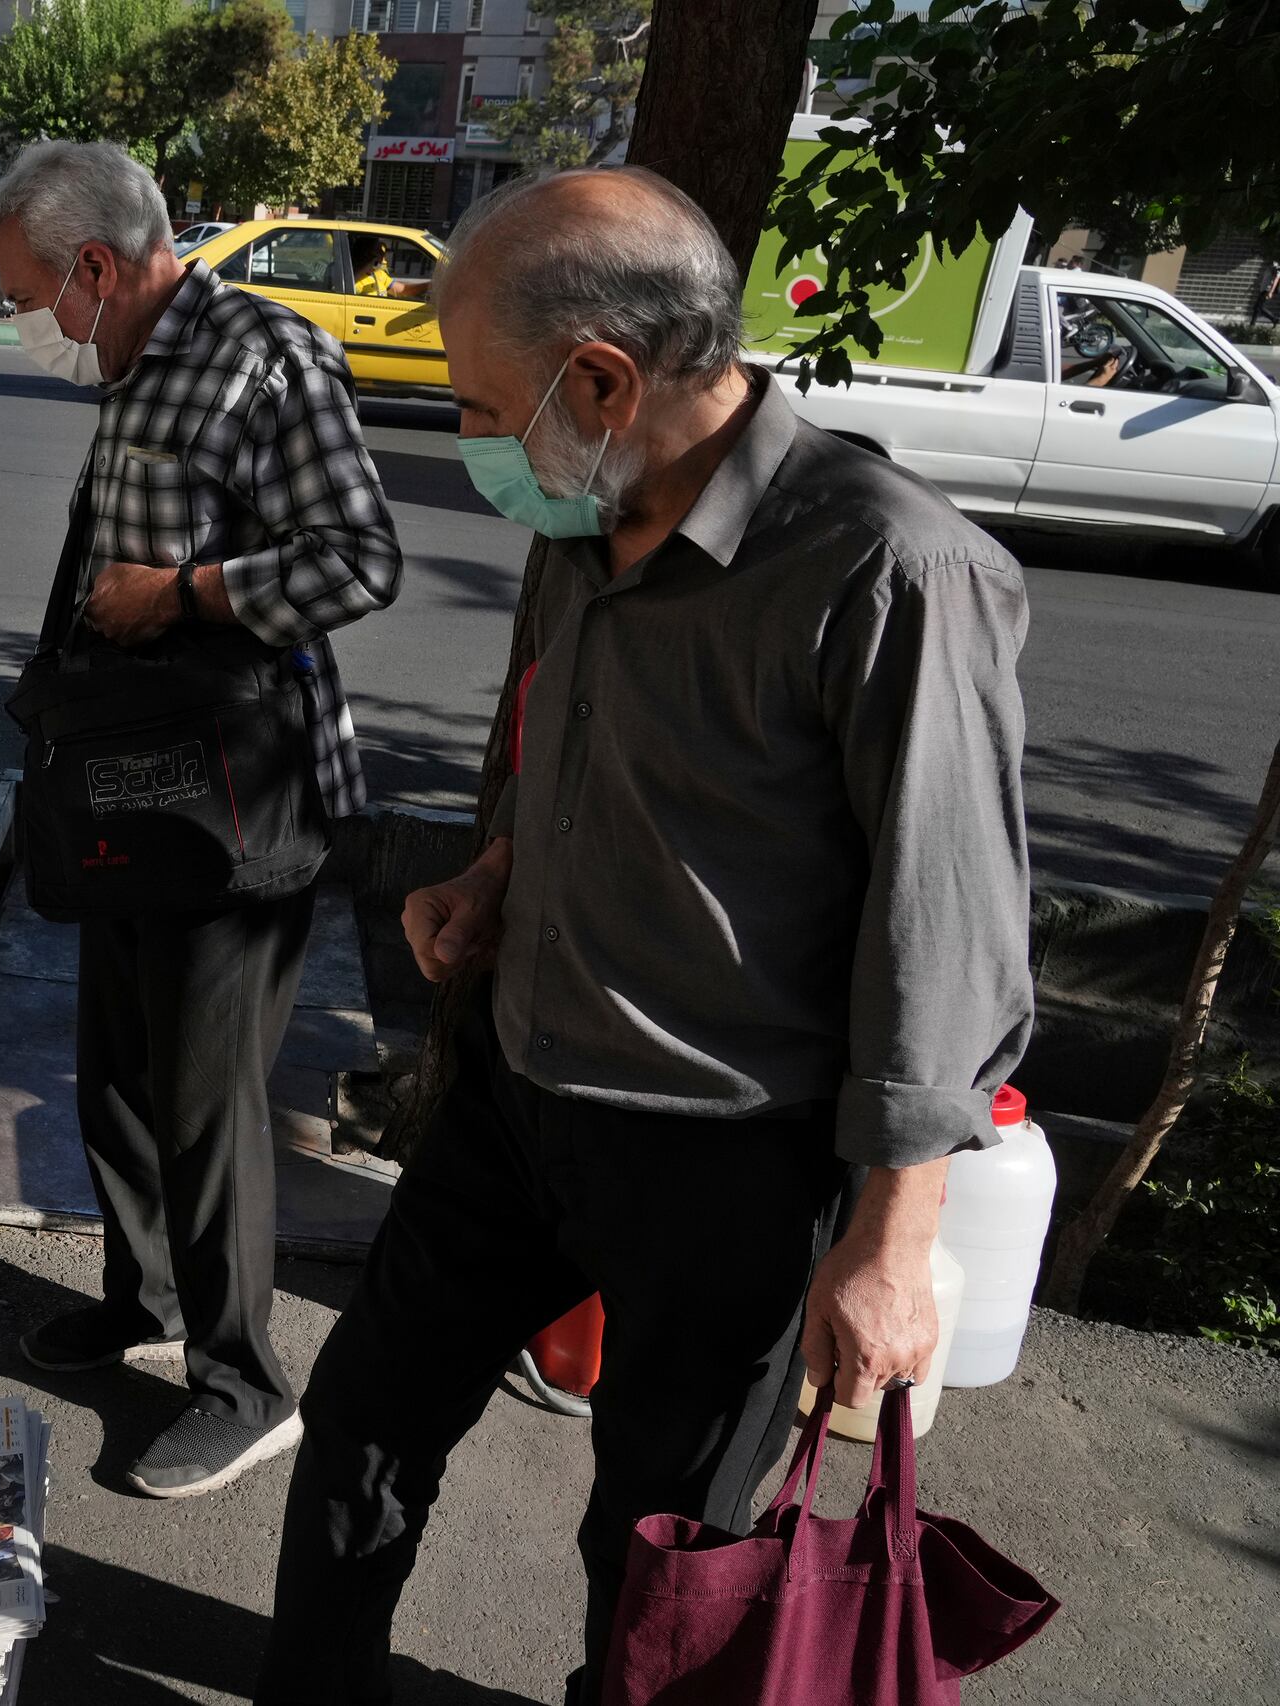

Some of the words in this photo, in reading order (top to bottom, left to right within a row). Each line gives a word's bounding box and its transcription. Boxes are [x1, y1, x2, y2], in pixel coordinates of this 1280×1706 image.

[374, 141, 408, 158] کشور
[410, 142, 449, 157] املاک
[91, 750, 200, 801] Sadr
[158, 787, 209, 808] مهندسی
